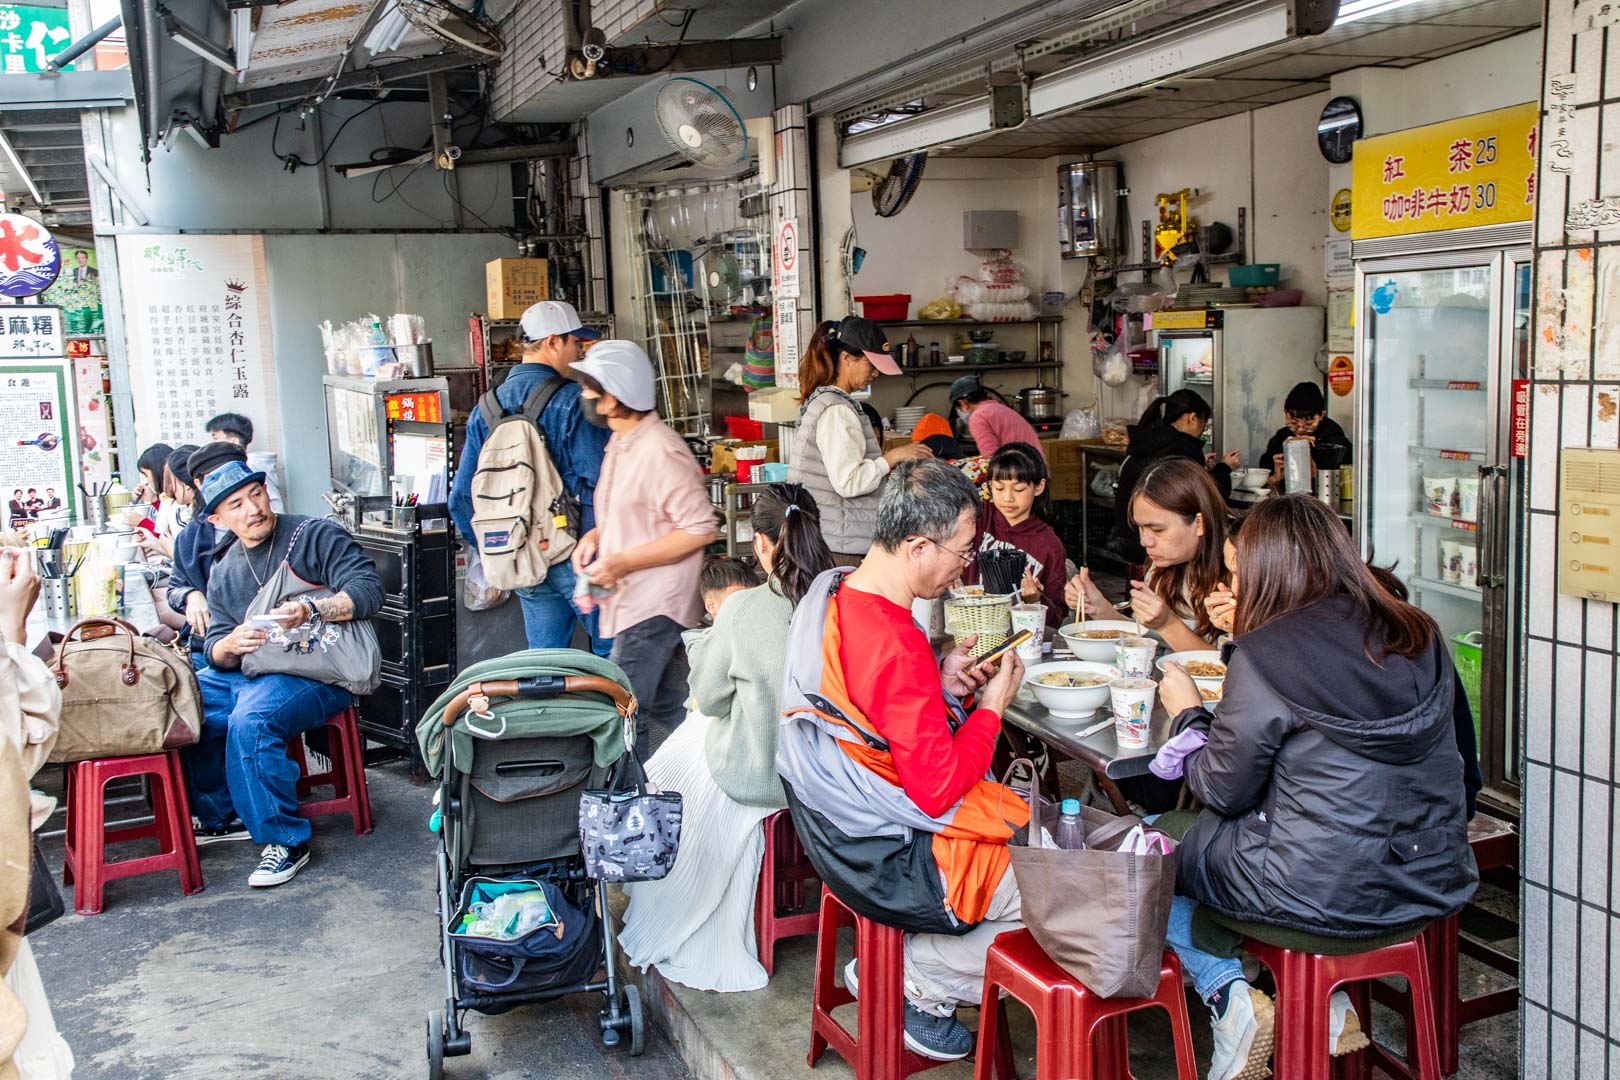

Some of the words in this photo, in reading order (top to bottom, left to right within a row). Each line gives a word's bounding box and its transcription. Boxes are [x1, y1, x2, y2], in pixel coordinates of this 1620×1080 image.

[1475, 136, 1497, 165] 25
[1383, 184, 1471, 221] 咖啡牛奶
[1474, 182, 1496, 209] 30
[225, 294, 250, 399] 綜合杏仁玉露
